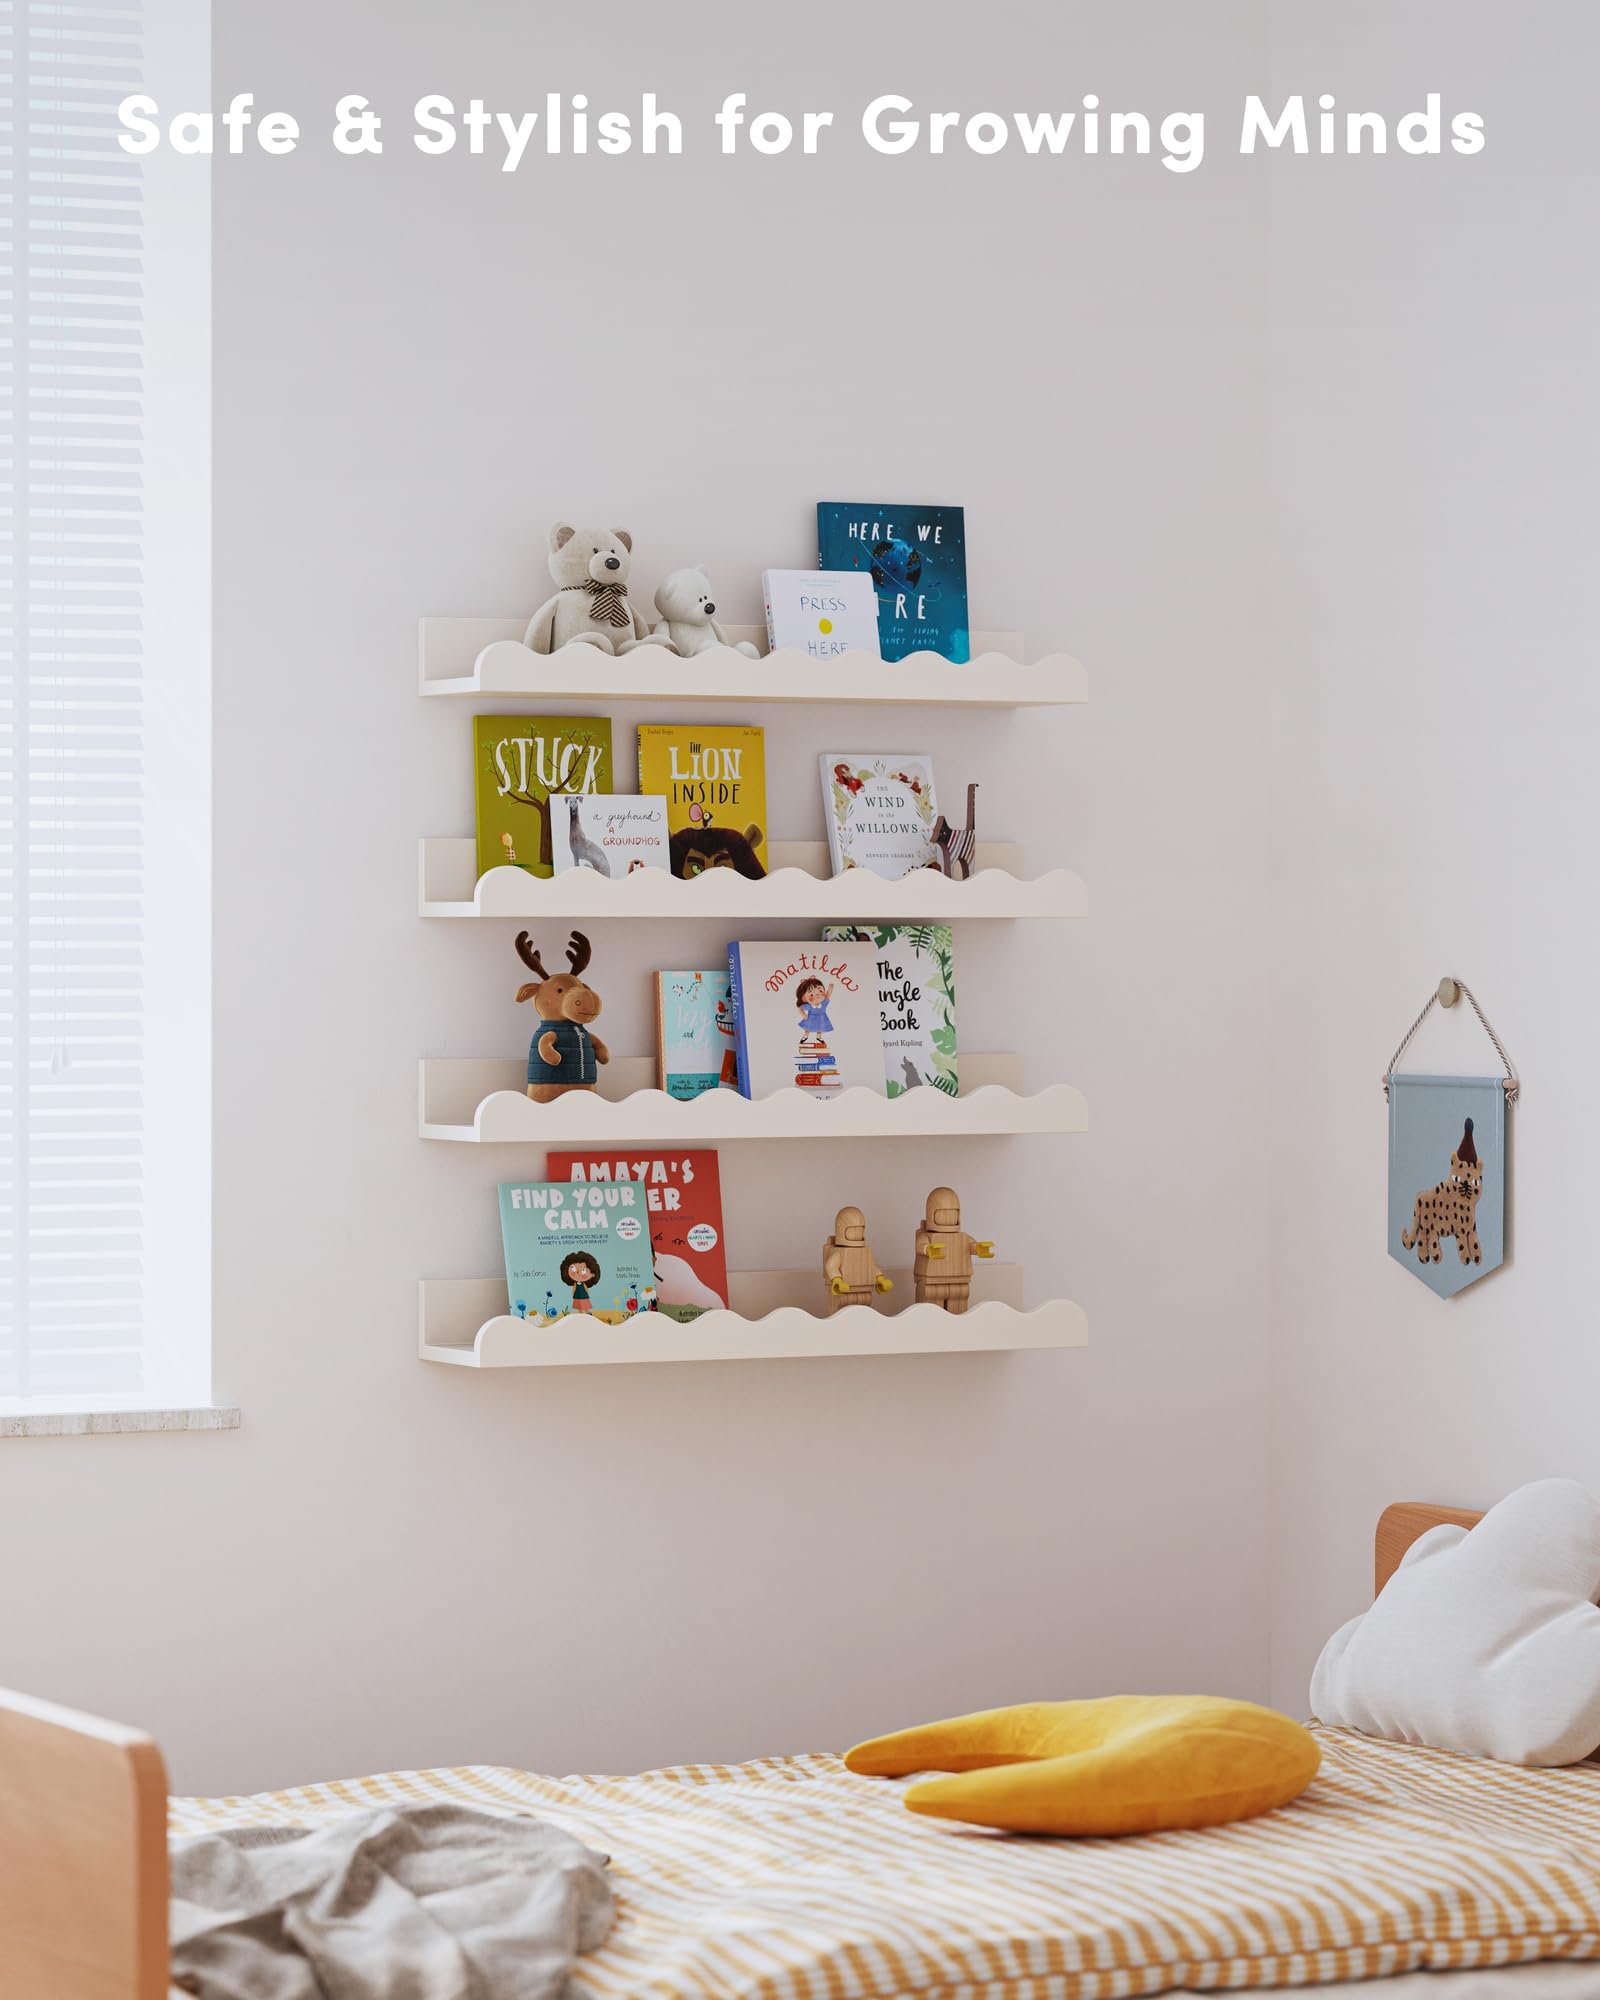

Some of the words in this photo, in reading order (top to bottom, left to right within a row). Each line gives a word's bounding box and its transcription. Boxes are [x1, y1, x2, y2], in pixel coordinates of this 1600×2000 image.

[849, 522, 894, 541] HERE
[917, 525, 943, 544] WE
[800, 596, 847, 611] PRESS
[895, 593, 926, 620] RE
[690, 742, 702, 753] THE
[495, 737, 603, 797] STUCK
[668, 747, 743, 781] LION
[673, 782, 741, 804] INSIDE
[864, 796, 905, 808] WIND
[606, 810, 662, 828] greyhound
[855, 823, 918, 834] WILLOWS
[602, 837, 661, 846] GROUNDHOG
[764, 953, 859, 993] Matilda
[876, 960, 904, 981] The
[900, 1039, 923, 1048] Kipling
[570, 1159, 695, 1184] AMAYA'S
[511, 1188, 564, 1210] FIND
[572, 1186, 637, 1208] YOUR
[544, 1209, 609, 1232] CALM
